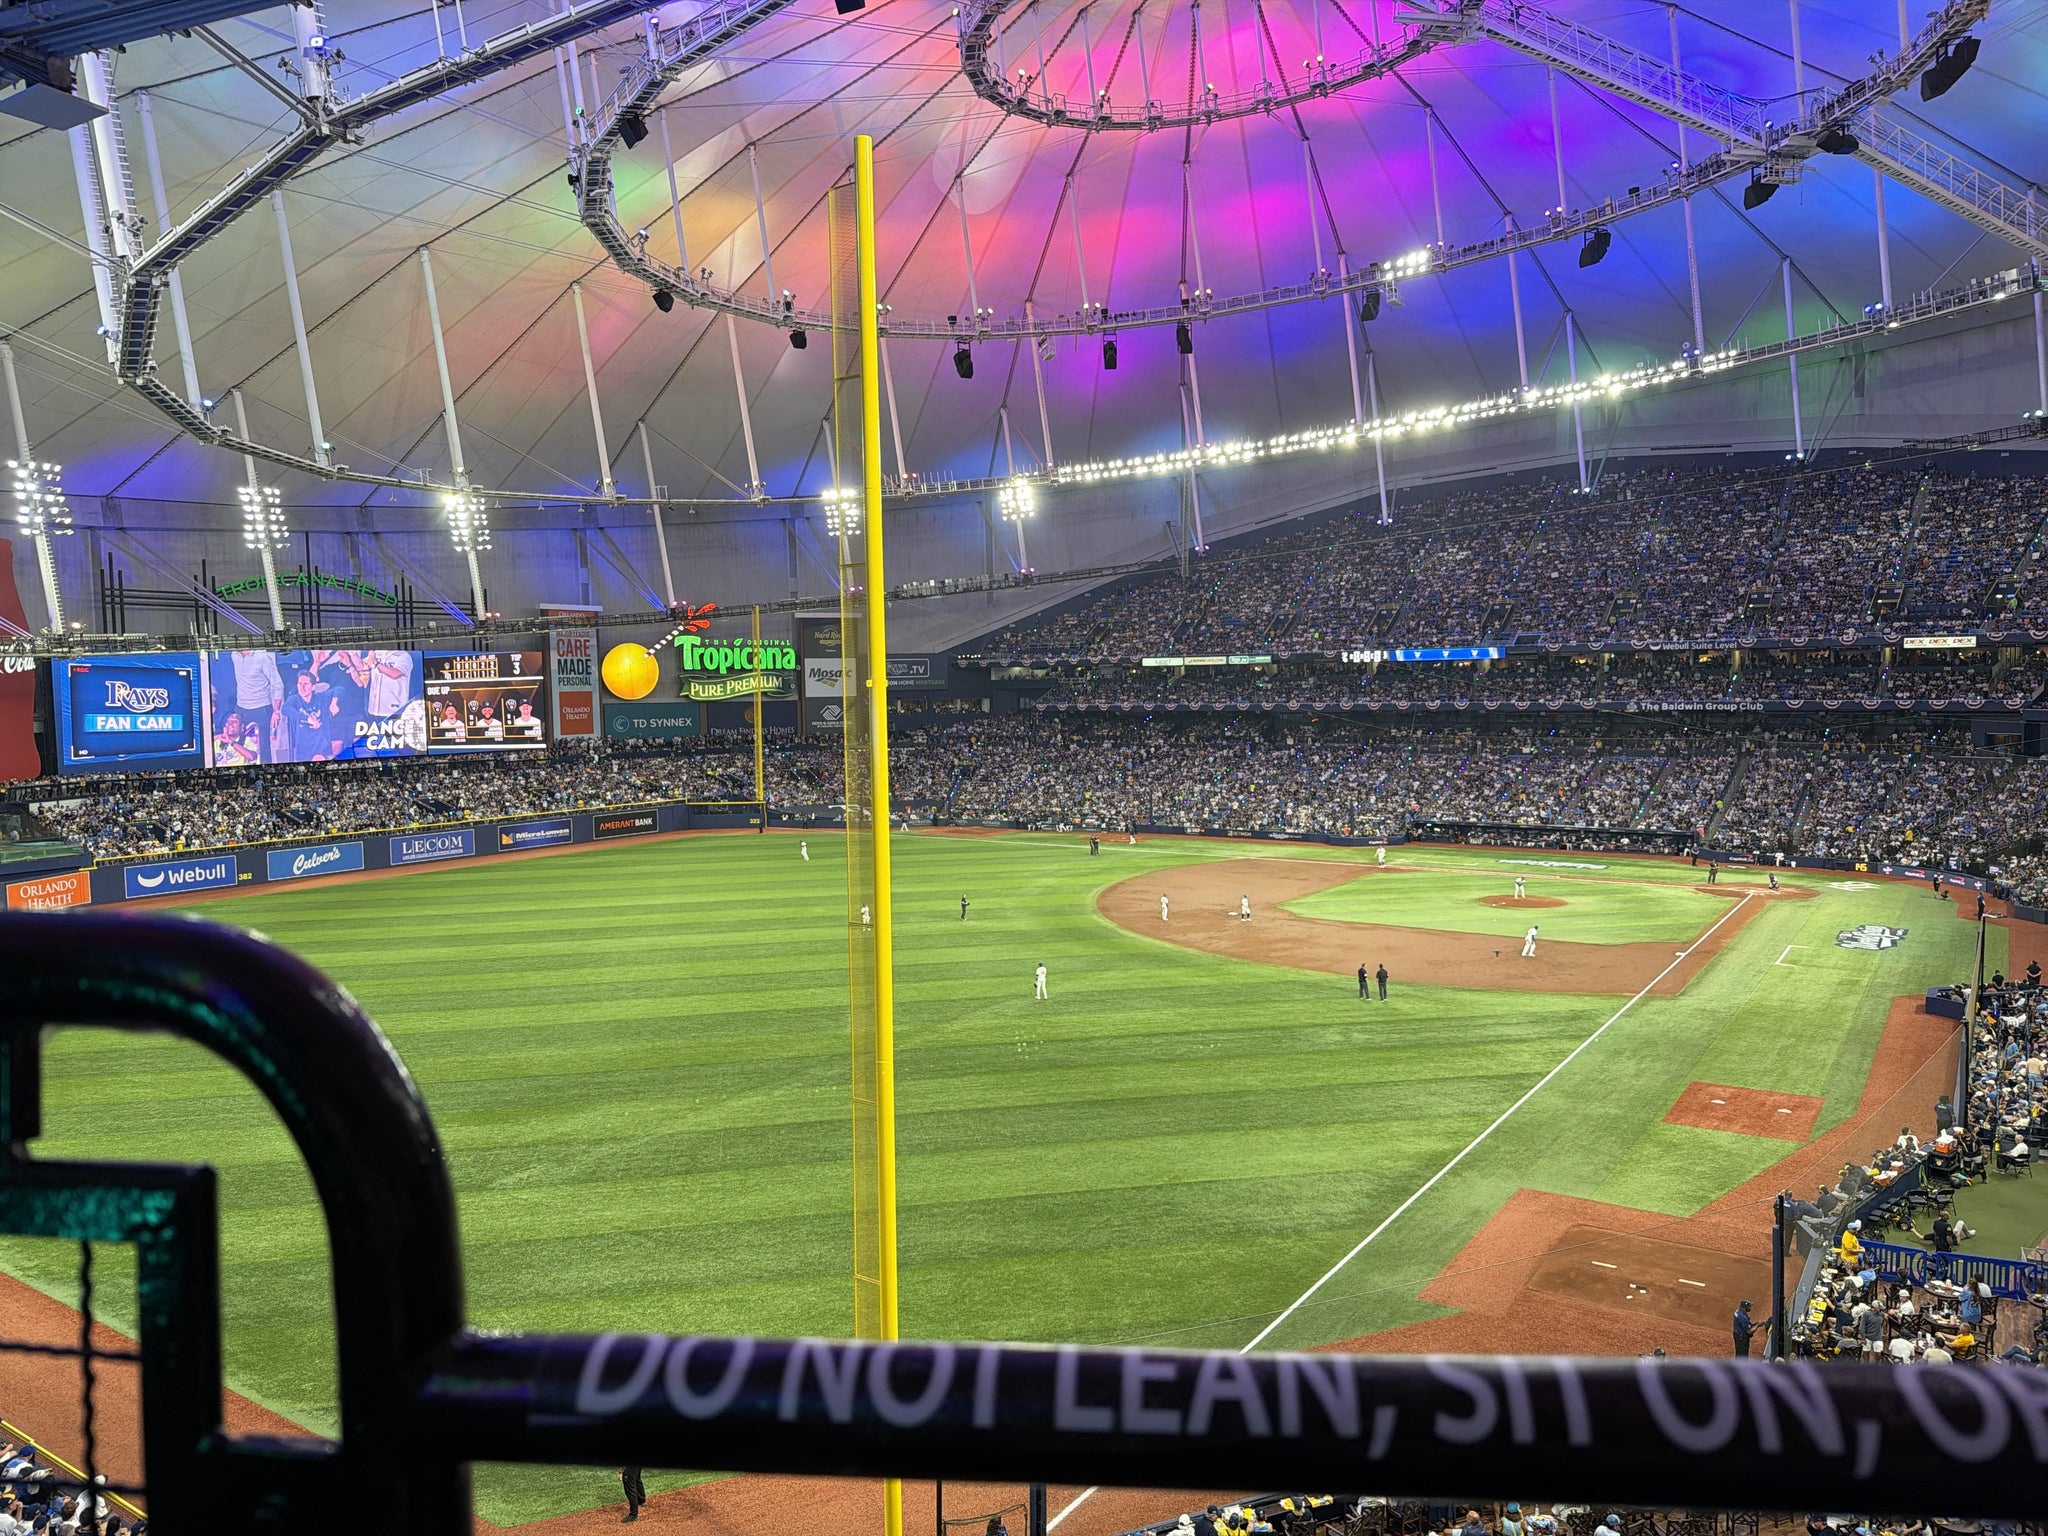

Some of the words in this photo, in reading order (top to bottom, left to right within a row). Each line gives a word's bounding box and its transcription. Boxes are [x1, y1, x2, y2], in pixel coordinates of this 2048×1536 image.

[344, 577, 398, 607] FIELD
[556, 639, 591, 657] CARE
[674, 635, 796, 674] Tropicana
[513, 662, 520, 675] 3
[557, 659, 592, 675] MADE
[558, 676, 592, 687] PERSONAL
[690, 682, 725, 697] PURE
[727, 676, 783, 693] PREMIUM
[427, 687, 440, 695] DUE
[441, 686, 451, 694] UP
[562, 706, 590, 714] ORLANDO
[1641, 702, 1659, 711] The
[1662, 702, 1701, 710] Baldwin
[1705, 702, 1738, 711] Group
[1739, 702, 1763, 711] Club
[96, 716, 130, 730] FAN
[137, 716, 172, 729] CAM
[566, 712, 588, 720] HEALTH
[633, 719, 647, 728] TD
[650, 717, 693, 728] SYNNEX
[769, 726, 795, 735] HOMES
[366, 735, 404, 750] CAM
[600, 819, 634, 831] AMERANT
[635, 817, 653, 827] BANK
[292, 846, 341, 875] Culver's
[168, 863, 226, 885] Webull
[238, 872, 253, 881] 382
[20, 878, 77, 899] ORLANDO
[27, 893, 73, 911] HEALTH
[575, 1333, 756, 1421] DO
